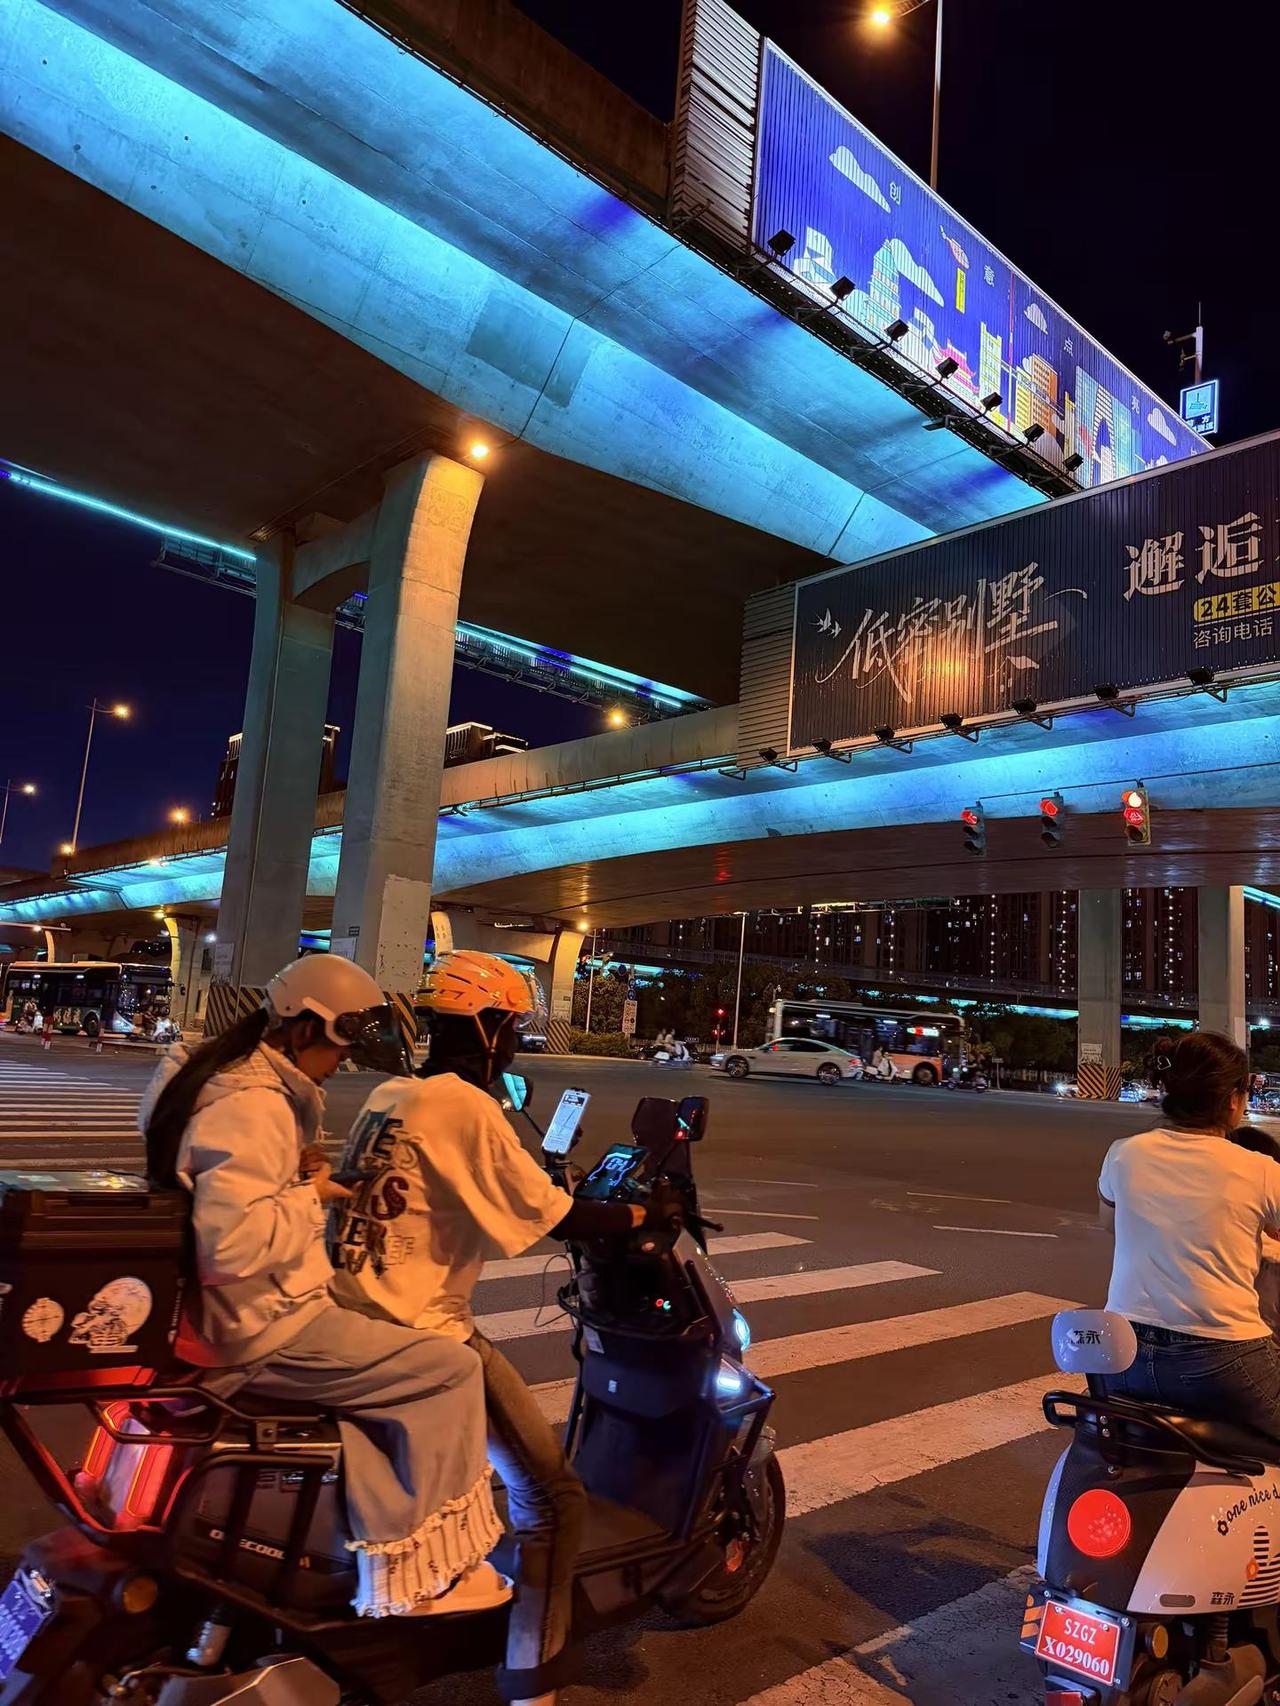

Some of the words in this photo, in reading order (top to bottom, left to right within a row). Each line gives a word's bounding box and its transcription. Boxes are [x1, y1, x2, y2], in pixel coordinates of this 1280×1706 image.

[1123, 511, 1280, 602] 邂逅
[1200, 585, 1277, 618] 24套公
[1193, 616, 1273, 649] 咨询电话
[1226, 1499, 1248, 1523] one
[1248, 1487, 1271, 1507] nice
[1064, 1618, 1097, 1645] SZGZ
[1042, 1635, 1110, 1676] X029060
